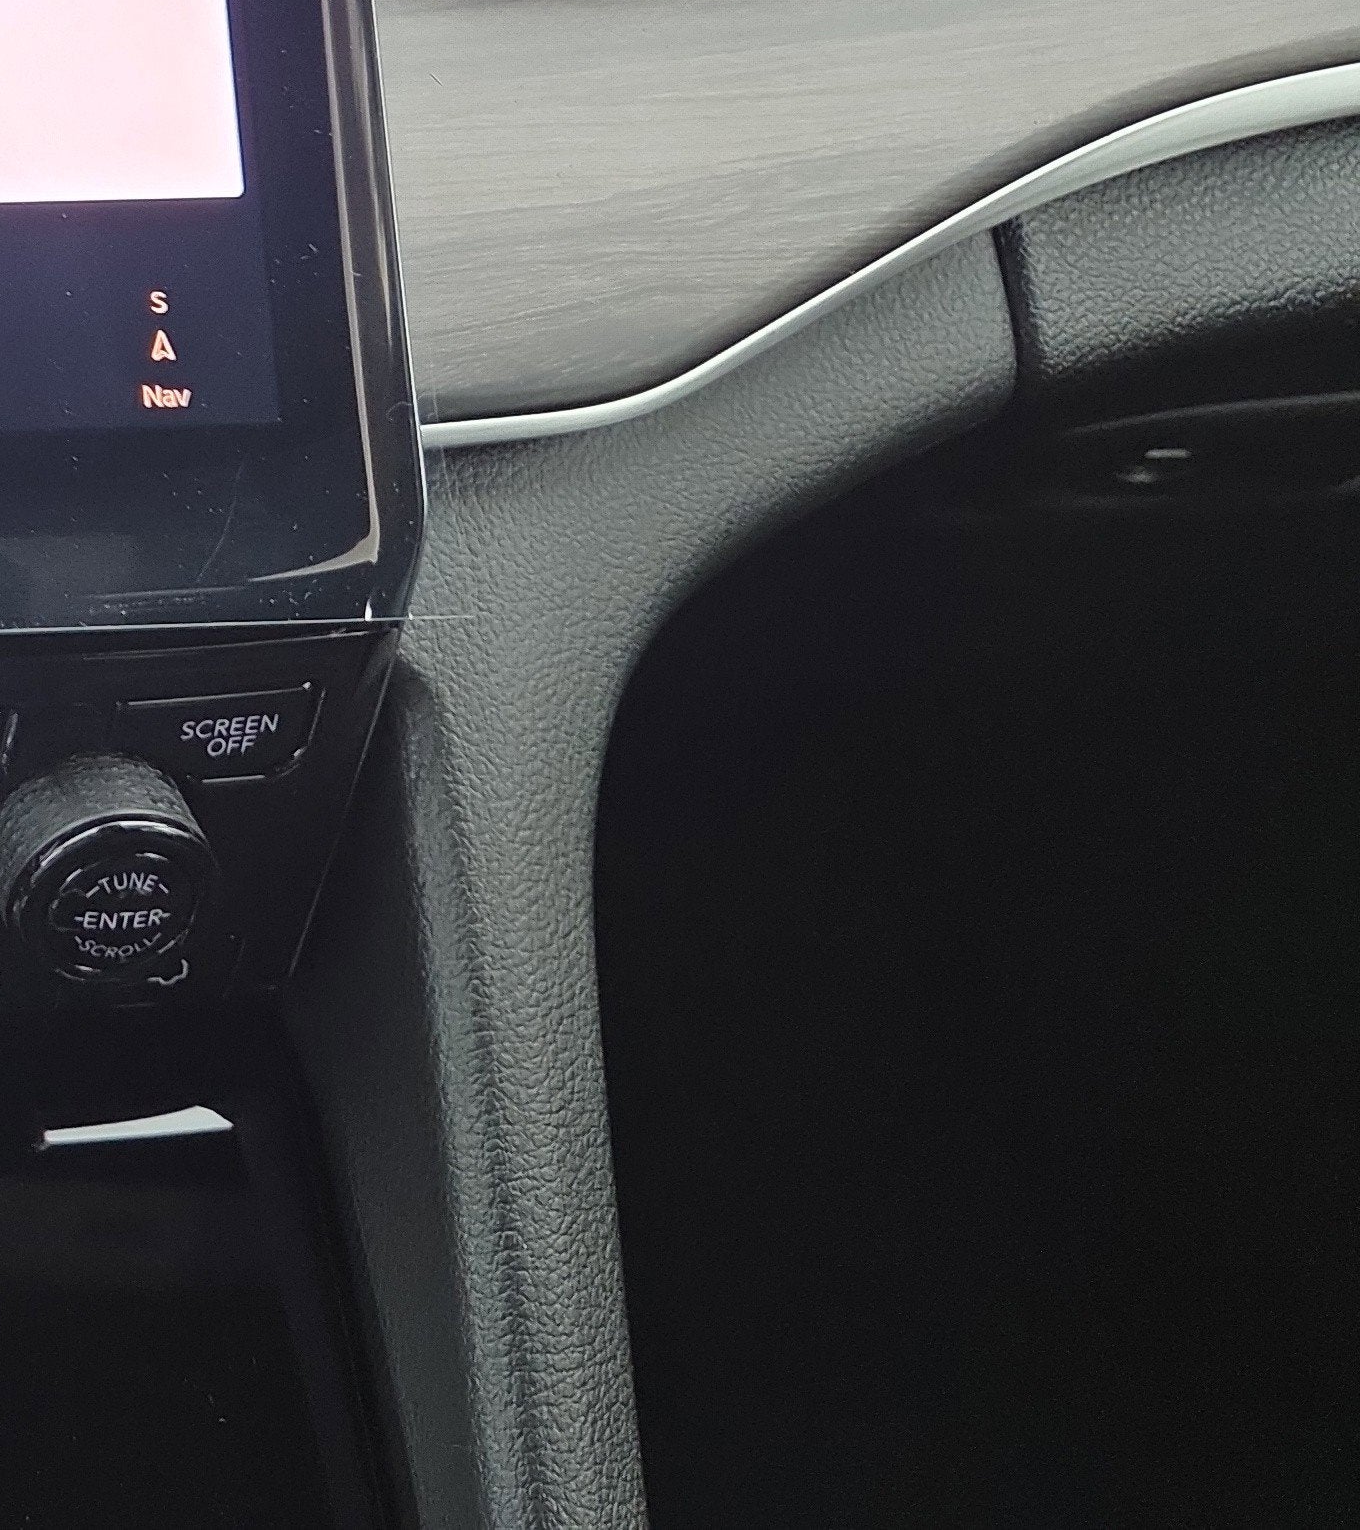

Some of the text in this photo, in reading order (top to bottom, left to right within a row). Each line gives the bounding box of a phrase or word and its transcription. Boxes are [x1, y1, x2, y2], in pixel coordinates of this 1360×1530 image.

[149, 290, 170, 315] S
[140, 383, 193, 410] Nav
[179, 712, 280, 743] SCREEN
[205, 732, 259, 758] OFF
[97, 871, 160, 895] TUNE
[82, 908, 164, 931] ENTER
[77, 932, 162, 959] SCROLL
